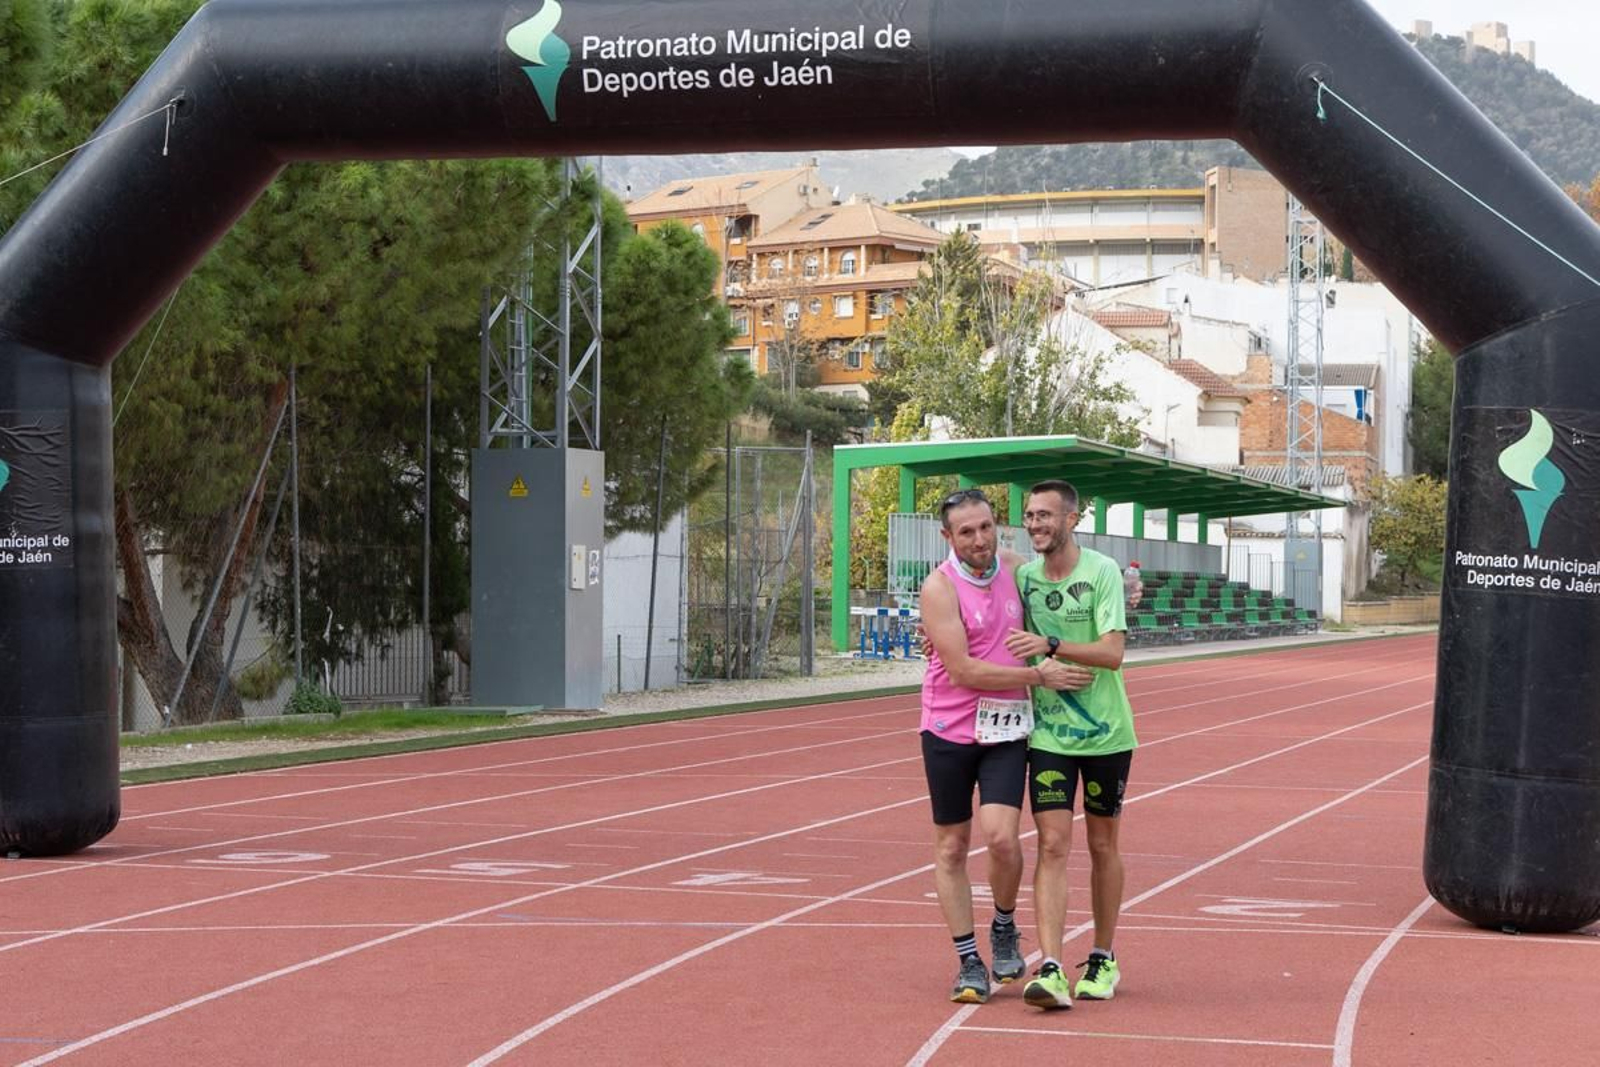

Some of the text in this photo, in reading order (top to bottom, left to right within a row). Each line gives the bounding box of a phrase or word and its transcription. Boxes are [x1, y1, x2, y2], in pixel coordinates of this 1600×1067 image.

[581, 23, 912, 60] Patronato Municipal de
[582, 60, 833, 97] Deportes de Jaén
[52, 534, 70, 547] de
[18, 549, 52, 564] Jaén
[1455, 551, 1600, 577] Patronato Municipal
[1467, 570, 1600, 594] Deportes de Jaén
[990, 712, 1022, 726] 111
